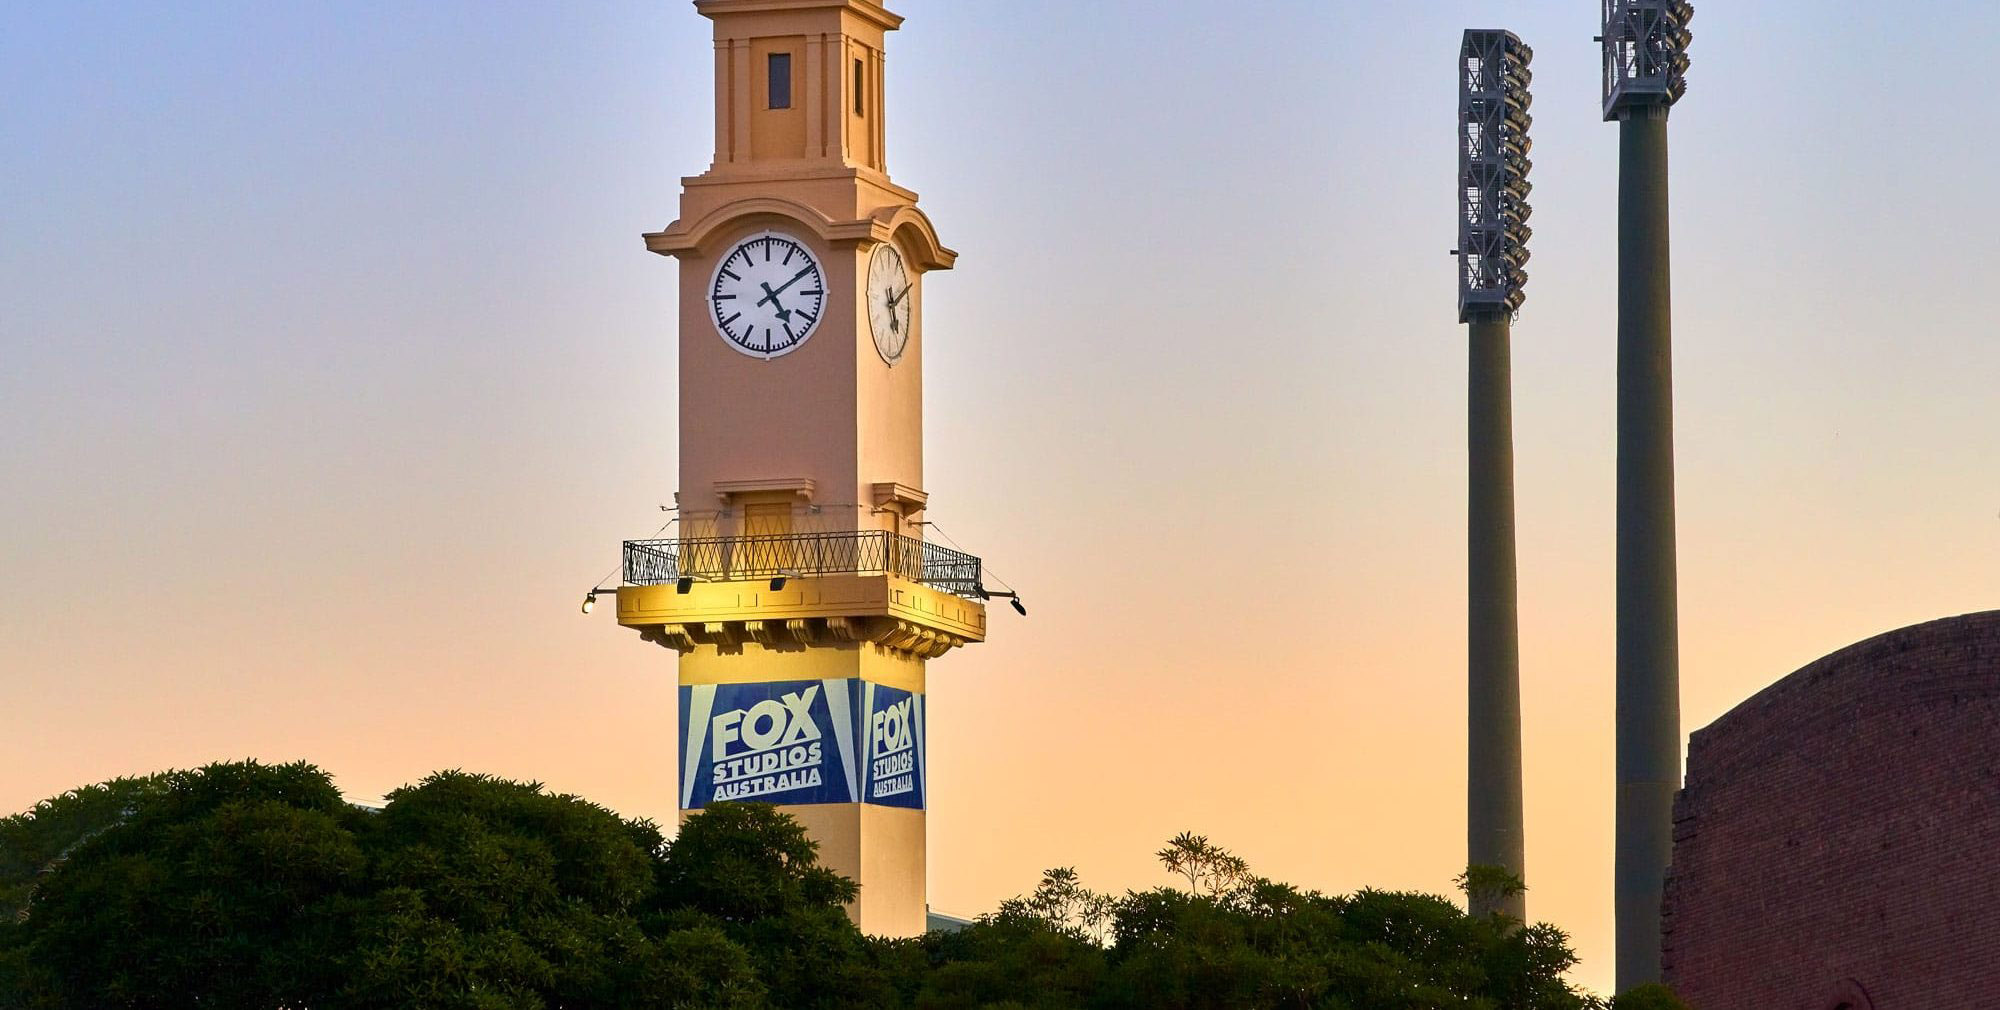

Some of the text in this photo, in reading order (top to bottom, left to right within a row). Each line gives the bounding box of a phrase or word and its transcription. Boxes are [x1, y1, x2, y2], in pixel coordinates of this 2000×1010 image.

[712, 684, 822, 763] FOX
[872, 696, 913, 760] FOX
[713, 742, 822, 782] STUDIOS
[873, 750, 913, 777] STUDIOS
[713, 767, 822, 801] AUSTRALIA
[873, 775, 913, 797] AUSTRALIA
